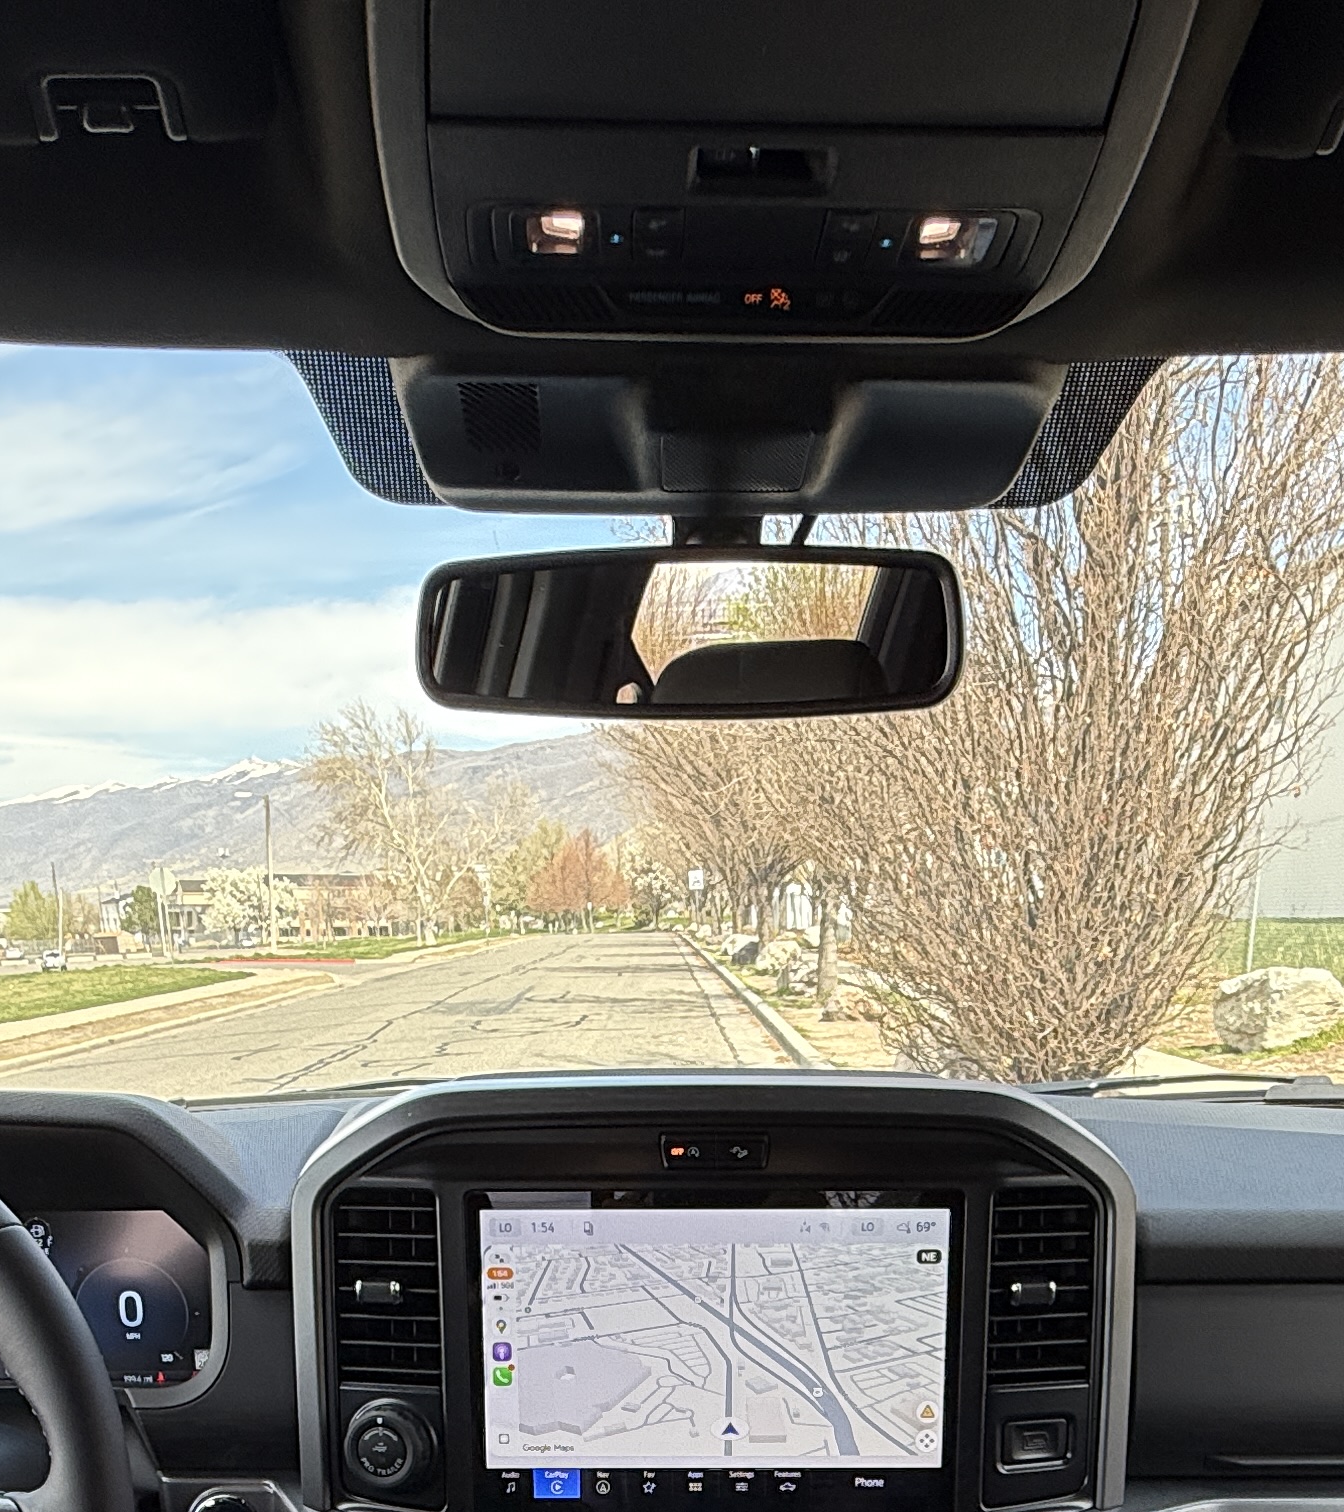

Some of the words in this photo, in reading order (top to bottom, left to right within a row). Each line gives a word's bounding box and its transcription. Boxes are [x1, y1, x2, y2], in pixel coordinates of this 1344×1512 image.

[744, 293, 763, 305] OFF
[499, 1222, 512, 1233] LO
[531, 1222, 555, 1233] 1:54
[861, 1221, 875, 1232] LO
[921, 1251, 938, 1262] NE
[118, 1290, 144, 1328] 0
[522, 1444, 552, 1453] Google
[553, 1444, 575, 1452] Maps
[854, 1477, 885, 1488] Phone
